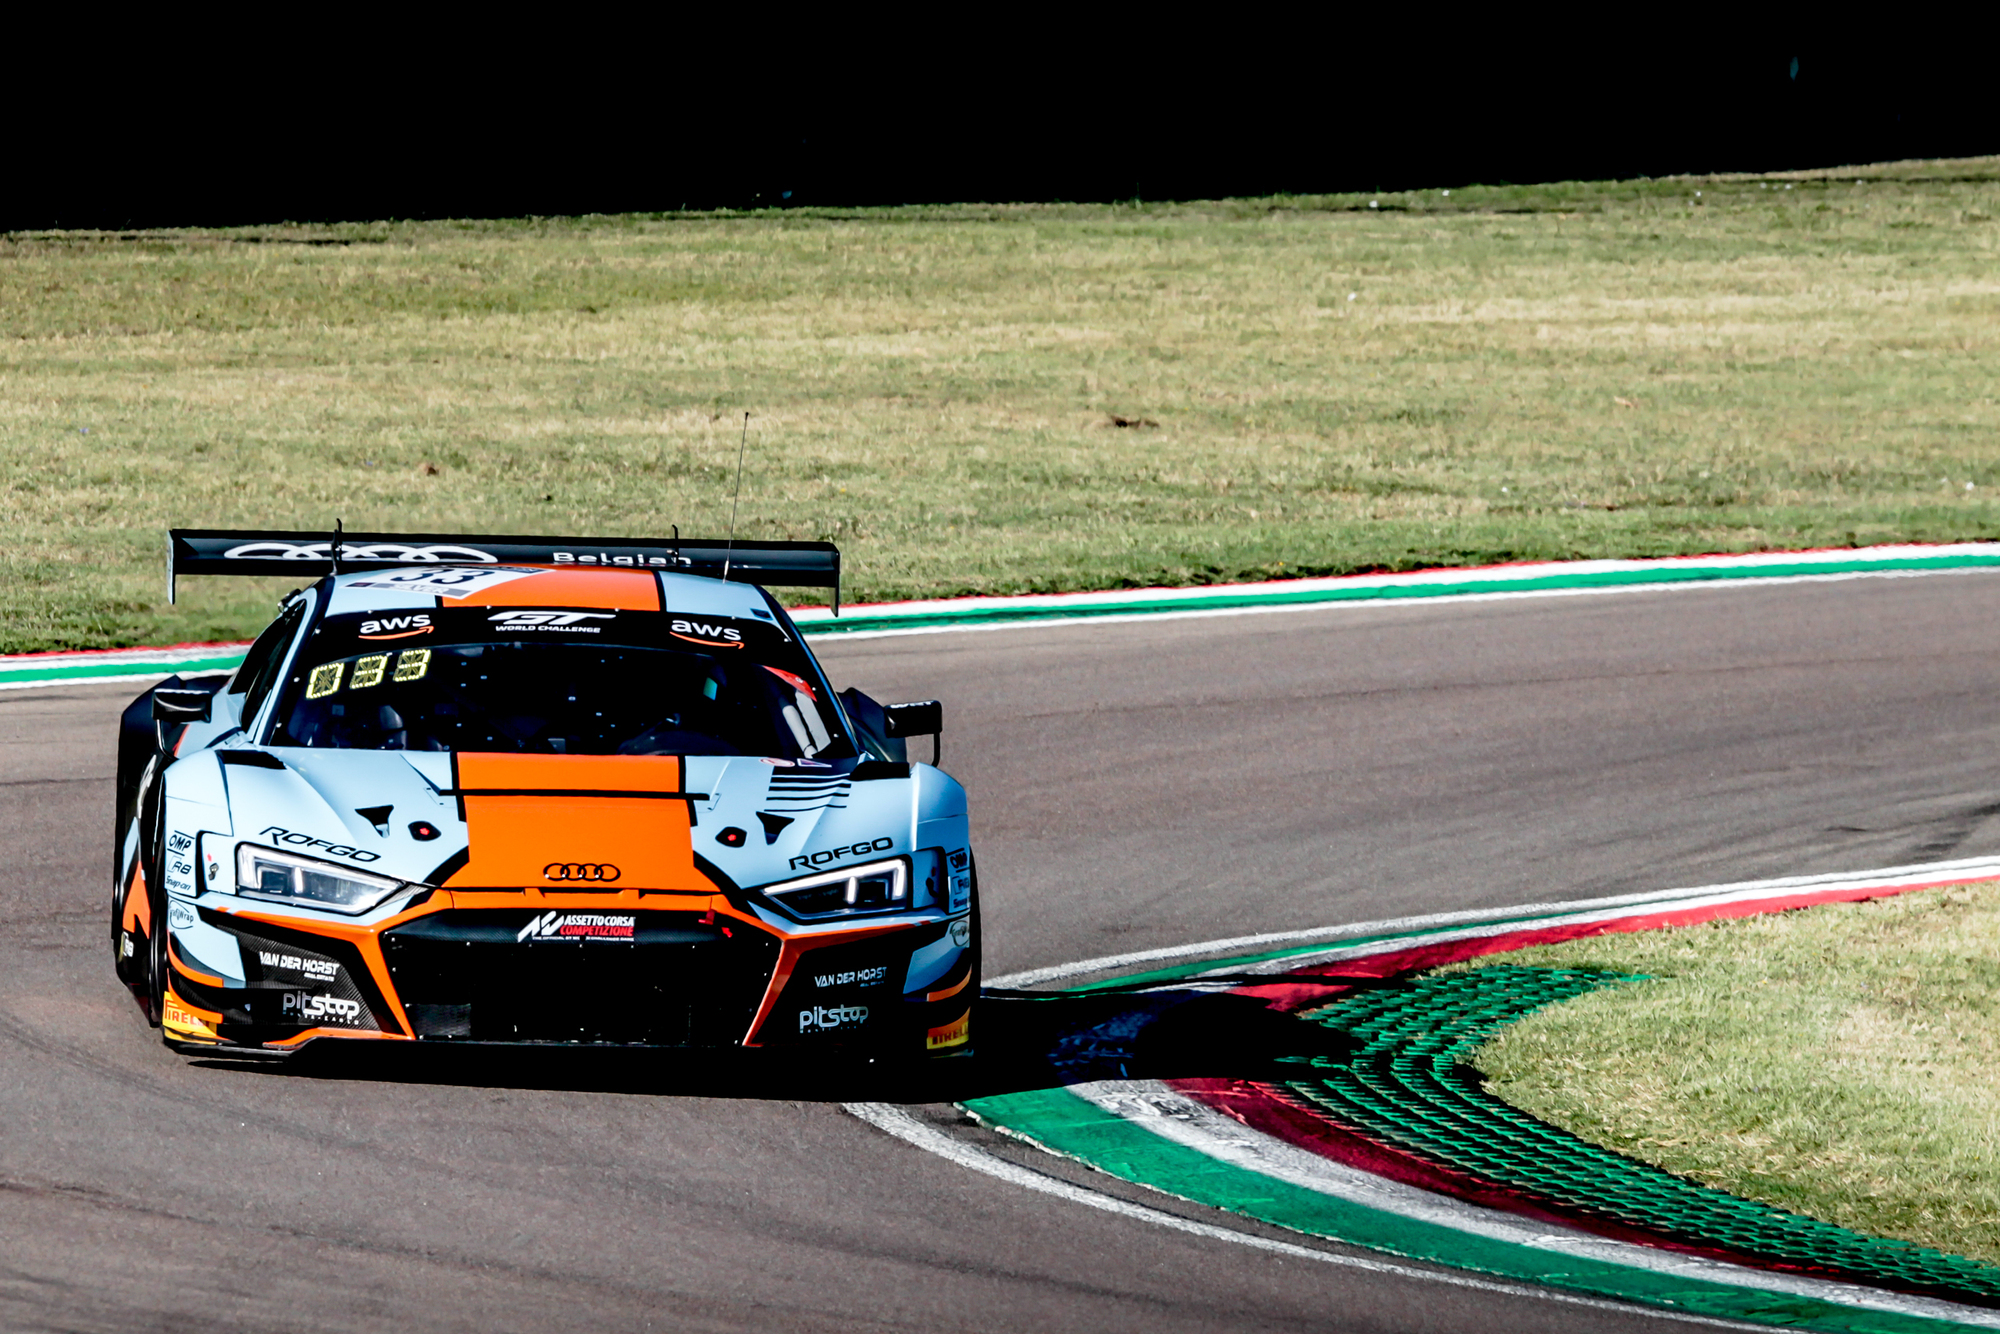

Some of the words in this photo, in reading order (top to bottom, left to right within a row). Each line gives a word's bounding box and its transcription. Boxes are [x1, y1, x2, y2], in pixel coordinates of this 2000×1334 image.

[360, 614, 431, 634] aws
[487, 610, 617, 625] GT
[671, 619, 742, 641] aws
[169, 834, 192, 851] OMP
[259, 826, 381, 862] ROFGO
[788, 837, 894, 871] ROFGO
[171, 860, 192, 875] R8
[560, 925, 634, 937] COMPETIZIONE
[564, 915, 604, 926] ASSETTO
[604, 916, 635, 927] CORSA
[259, 951, 280, 967] VAN
[279, 955, 301, 970] DER
[302, 958, 340, 975] HORST
[814, 974, 835, 987] VAN
[836, 972, 856, 985] DER
[857, 966, 887, 981] HORST
[283, 990, 360, 1020] pitstop
[799, 1004, 869, 1029] pitstop
